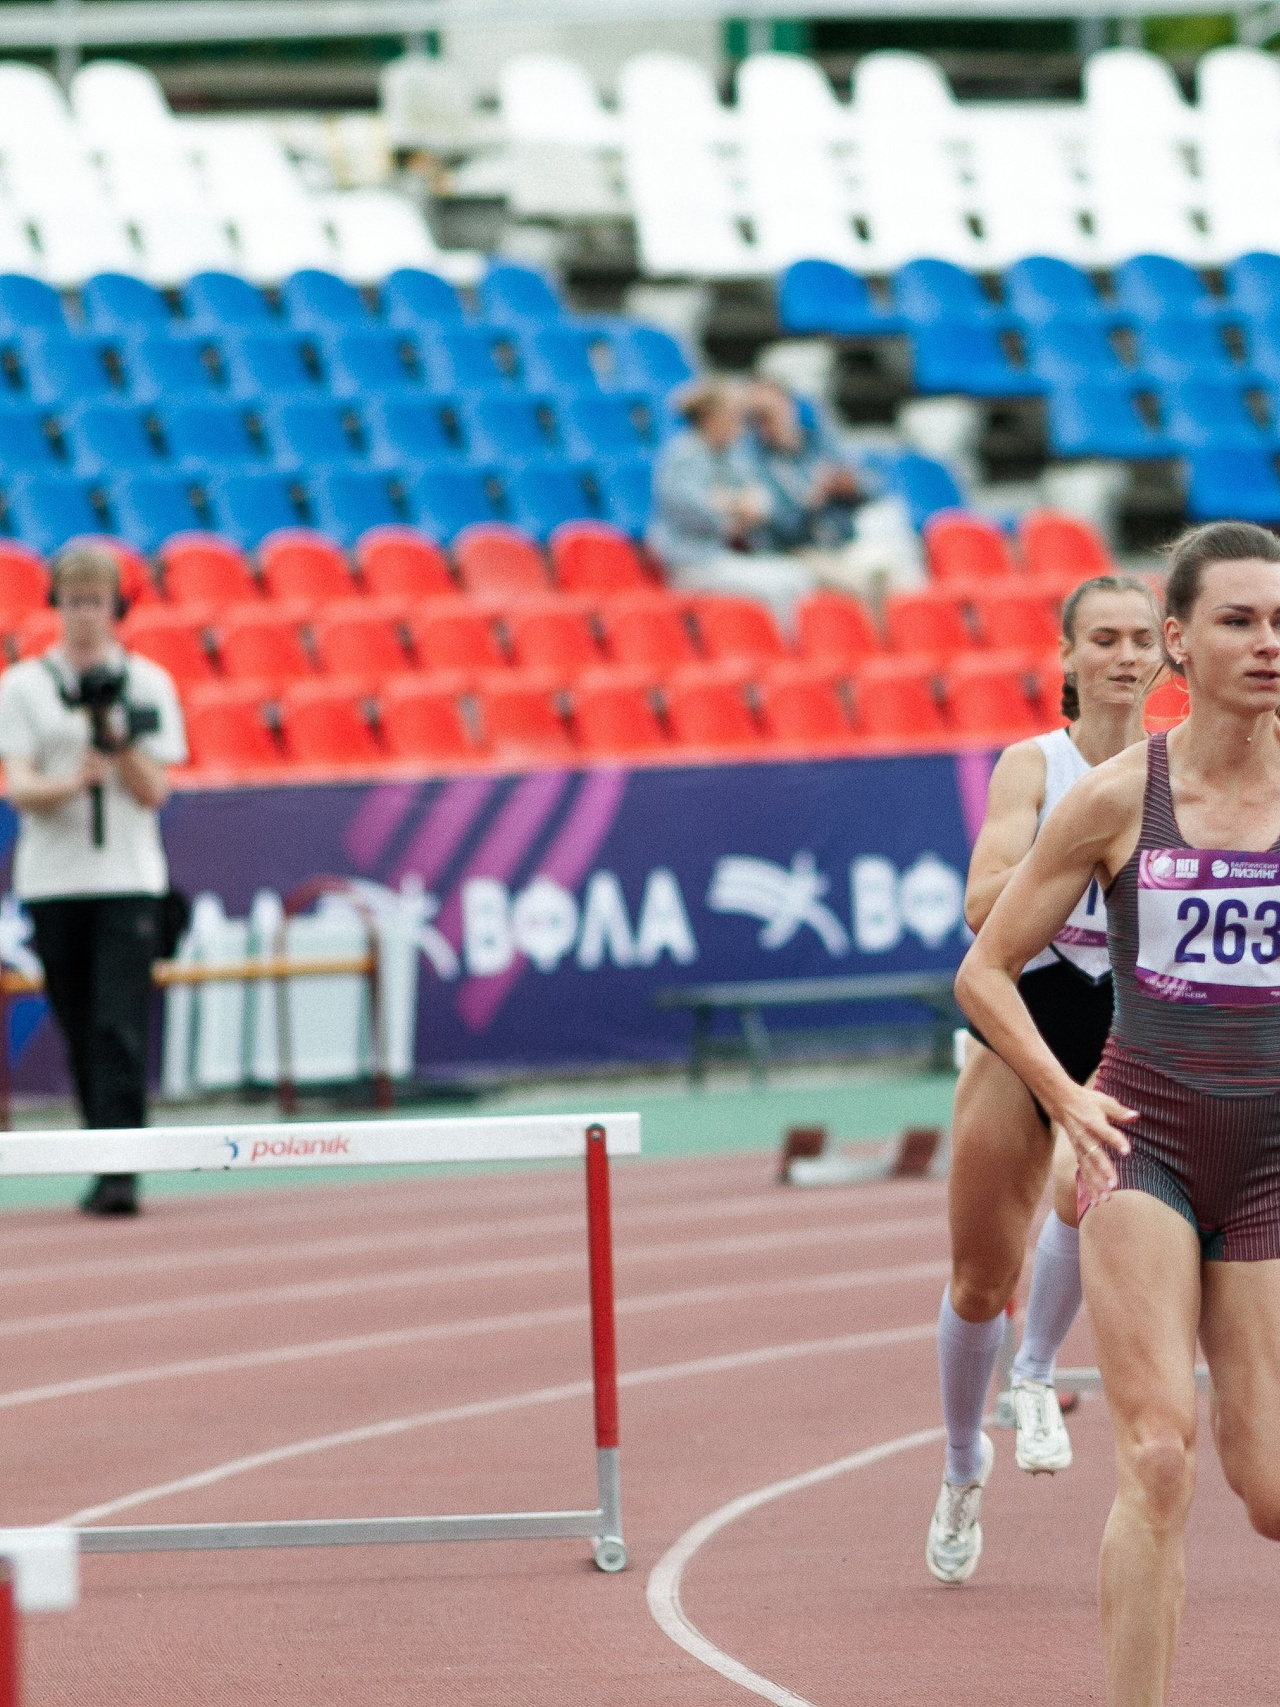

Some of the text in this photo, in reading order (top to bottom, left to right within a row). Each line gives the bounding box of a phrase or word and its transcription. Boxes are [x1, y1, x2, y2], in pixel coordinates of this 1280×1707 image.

[852, 852, 975, 955] ВФ
[1229, 867, 1278, 880] ЛИЗИНГ
[461, 866, 698, 976] ВФЛА
[251, 1134, 349, 1163] polanik
